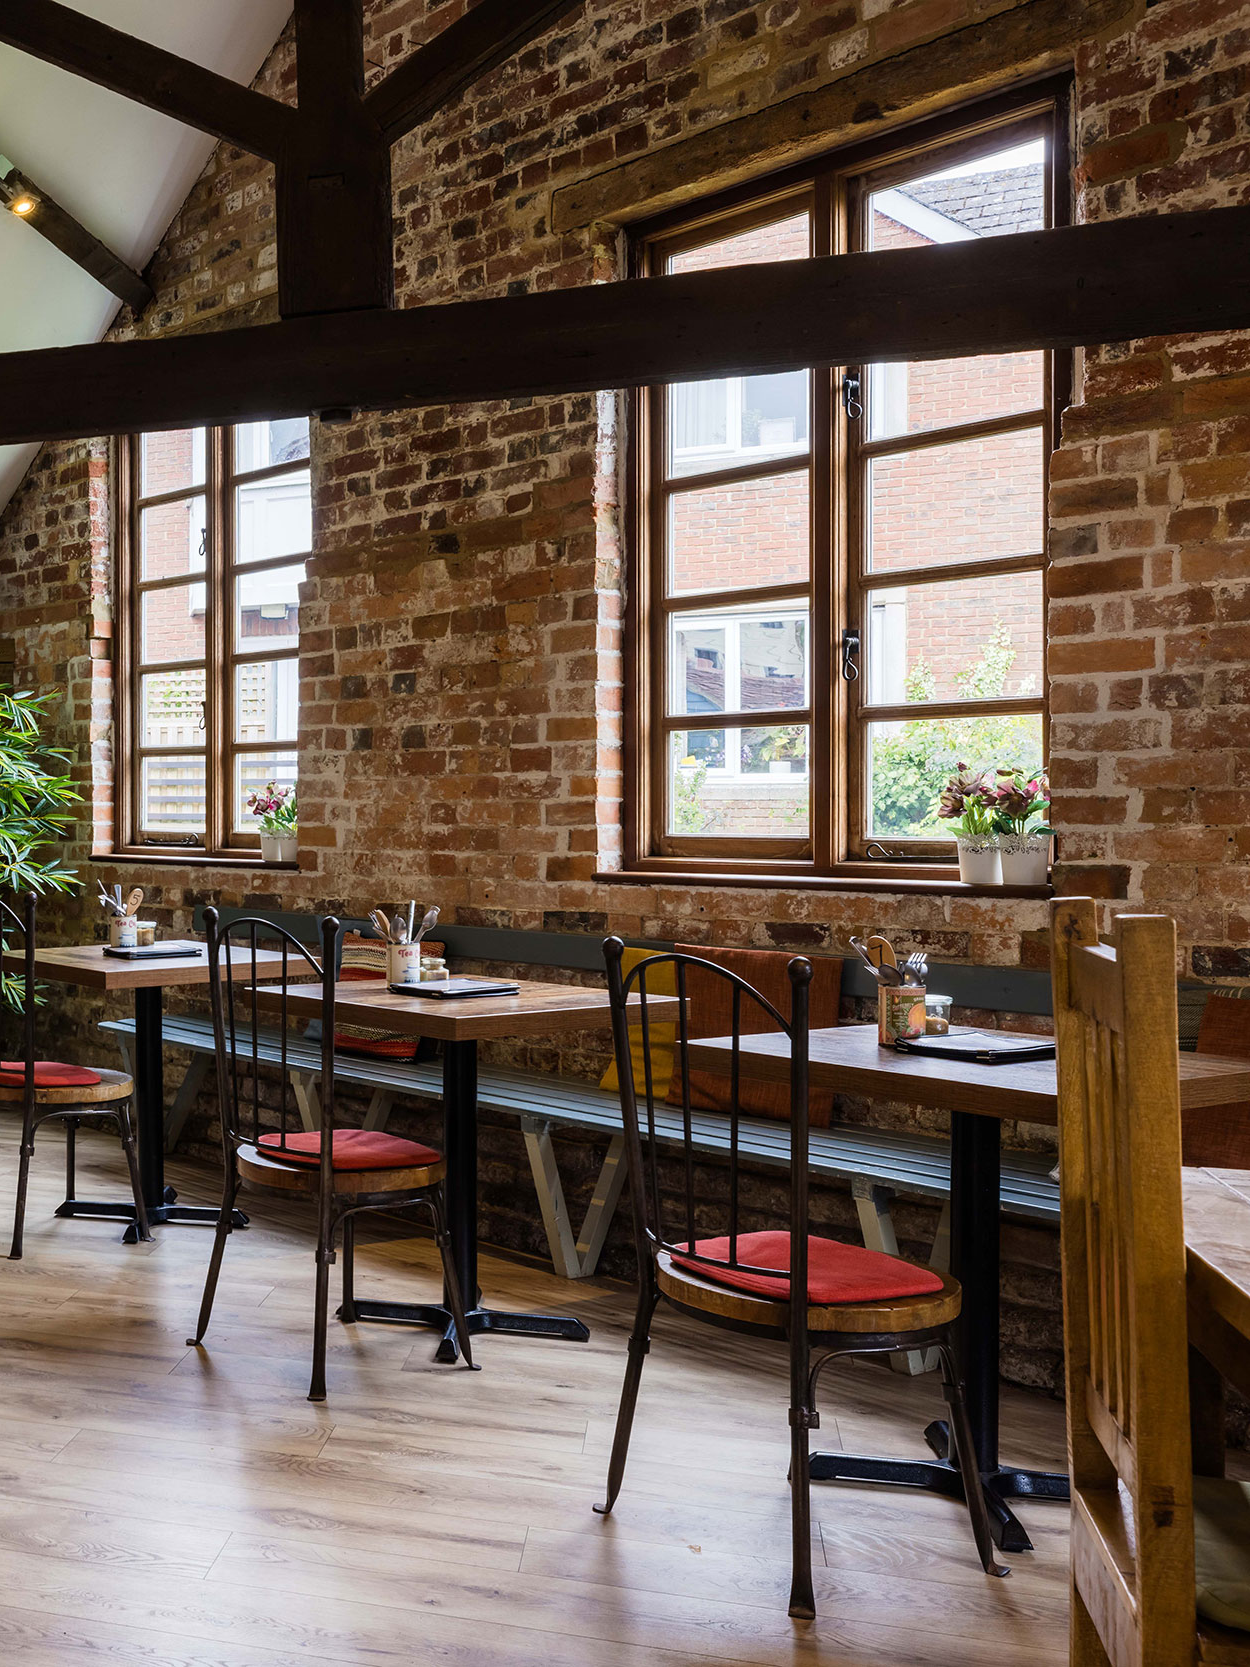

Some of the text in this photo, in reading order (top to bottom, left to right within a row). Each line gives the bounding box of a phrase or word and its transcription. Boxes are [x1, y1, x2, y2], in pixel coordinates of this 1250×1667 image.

[130, 895, 141, 905] 5
[115, 920, 127, 928] Tea
[398, 949, 413, 958] Tea
